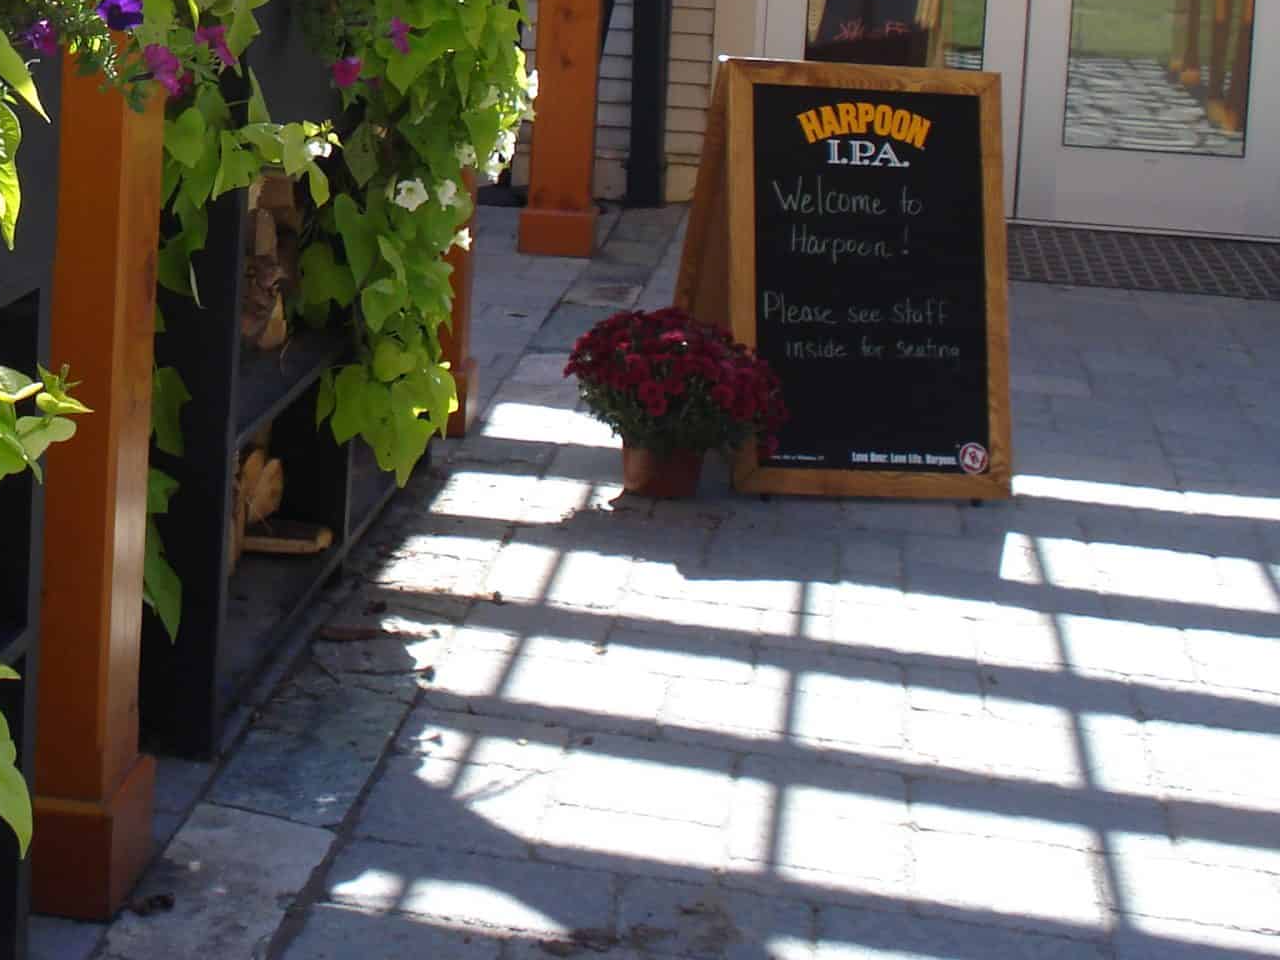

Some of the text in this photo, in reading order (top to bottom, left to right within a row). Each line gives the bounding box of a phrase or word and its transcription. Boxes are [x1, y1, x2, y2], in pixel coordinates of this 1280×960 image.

[797, 103, 931, 149] HARPOON
[771, 175, 923, 216] Welcome to
[762, 289, 838, 325] Please
[847, 304, 881, 324] see
